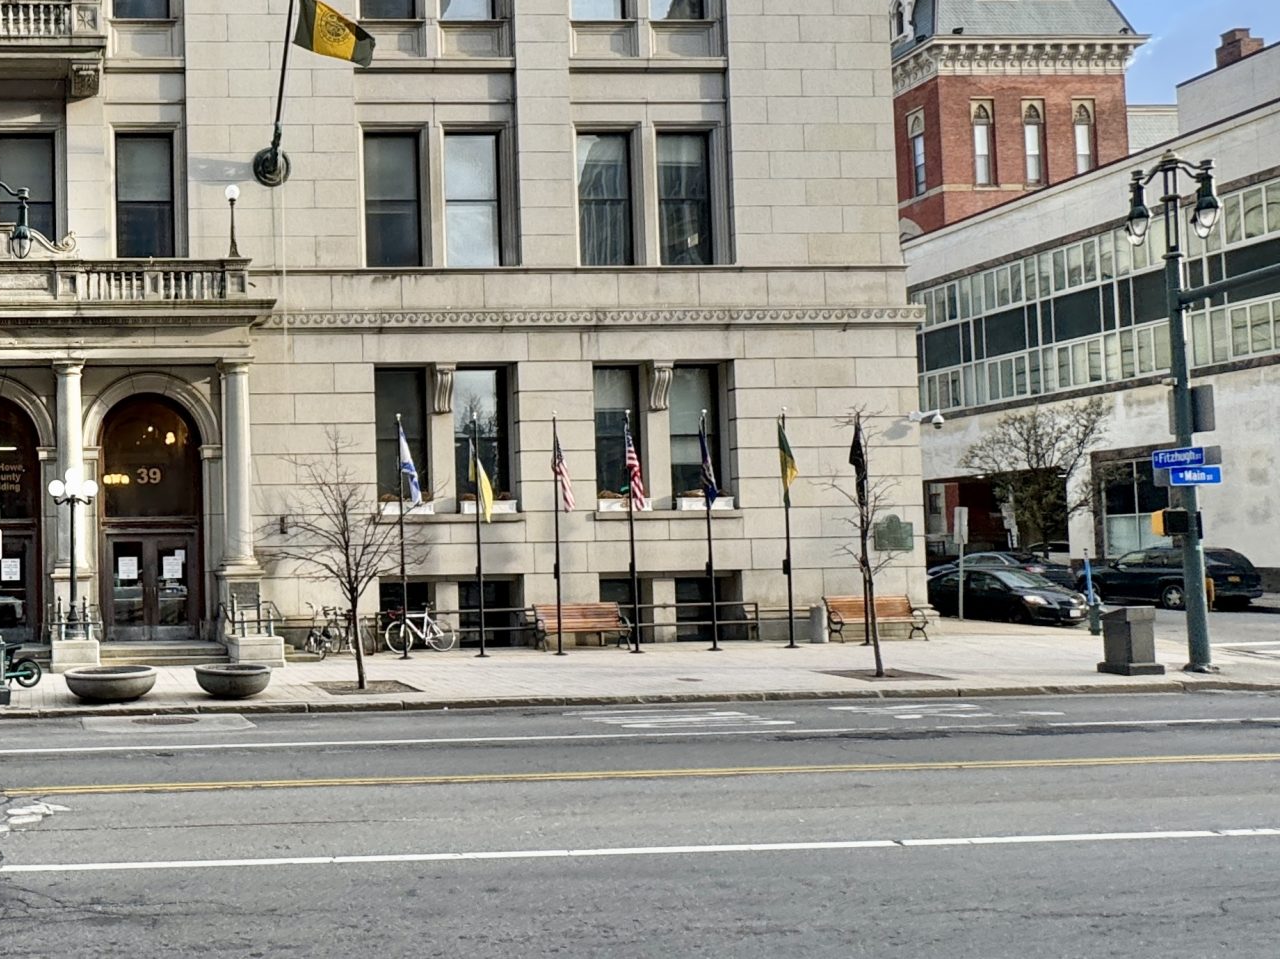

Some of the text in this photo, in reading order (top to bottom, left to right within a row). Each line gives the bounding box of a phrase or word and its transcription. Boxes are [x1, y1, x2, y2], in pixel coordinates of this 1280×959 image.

[1159, 450, 1195, 463] Fitzhugh
[136, 467, 161, 484] 39
[1184, 470, 1206, 481] Main
